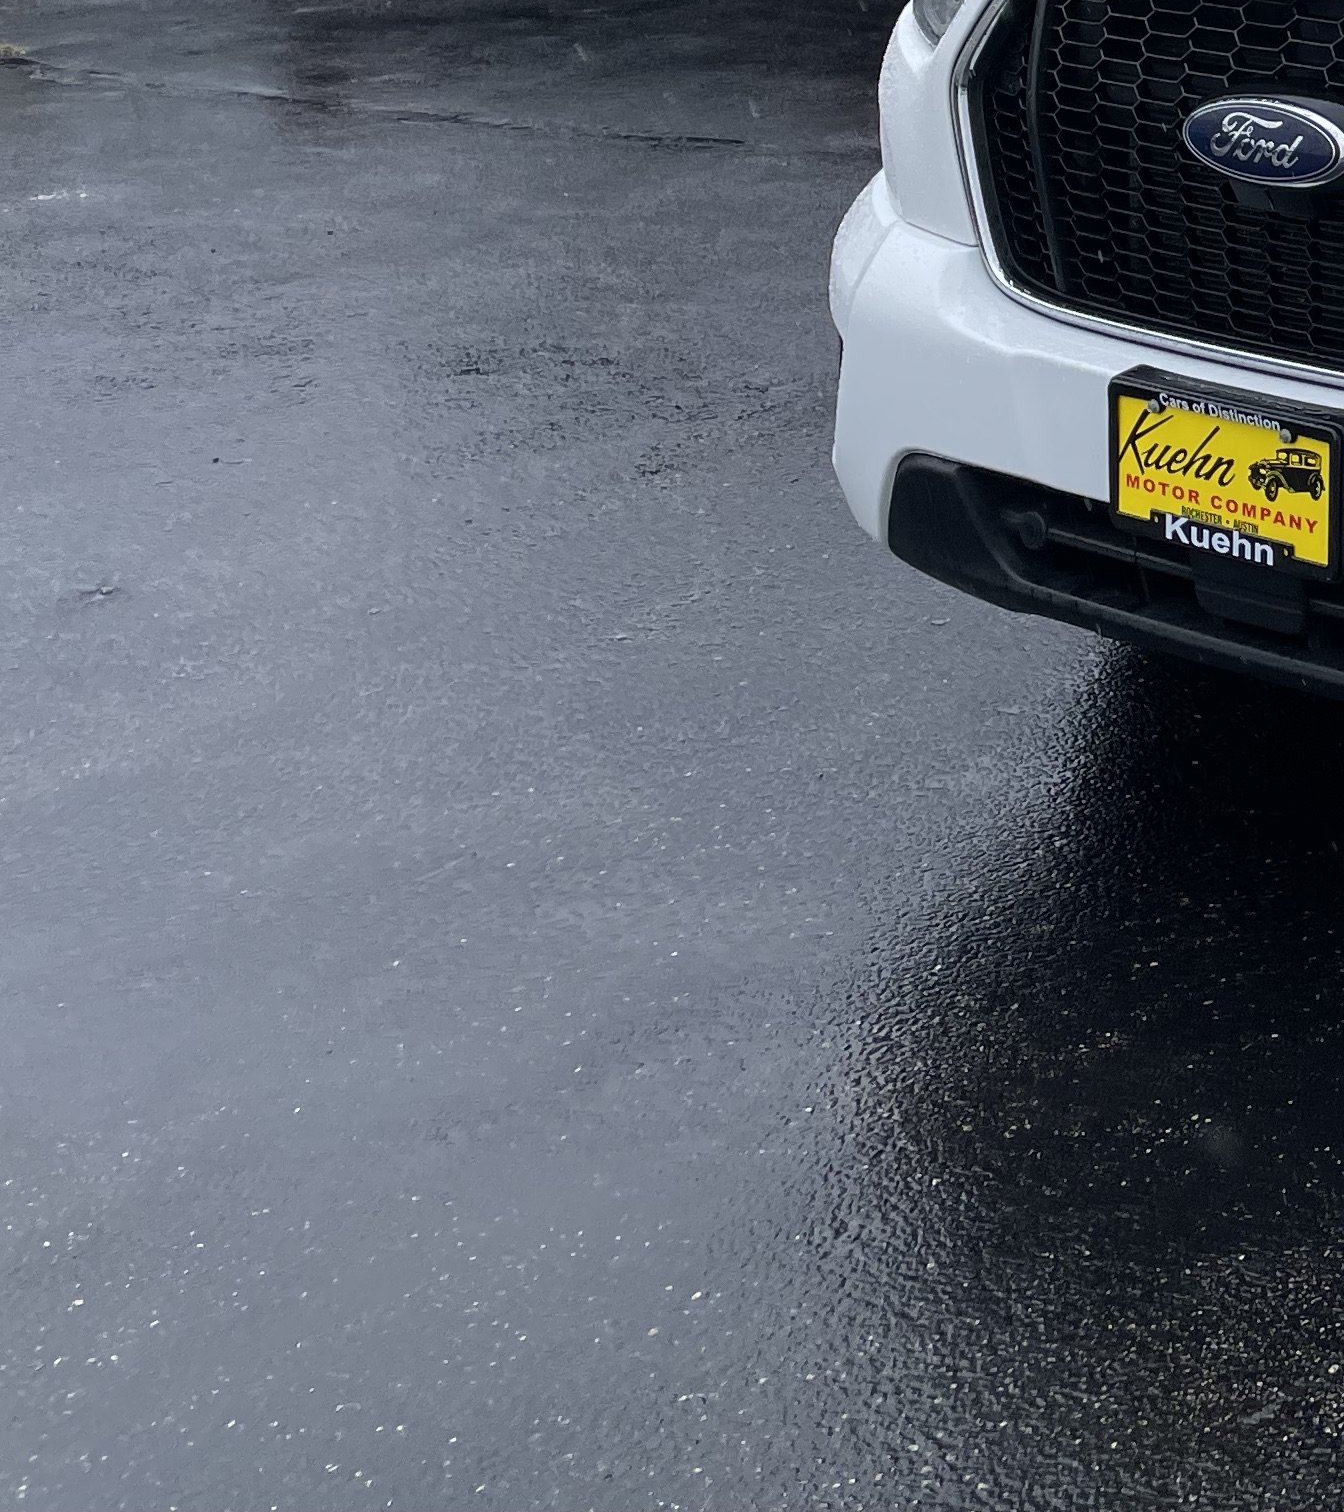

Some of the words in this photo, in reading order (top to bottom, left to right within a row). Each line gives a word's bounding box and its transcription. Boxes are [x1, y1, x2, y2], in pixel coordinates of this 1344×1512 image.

[1210, 111, 1304, 169] Ford
[1159, 392, 1189, 411] Cars
[1192, 402, 1205, 414] of
[1208, 404, 1281, 432] Distinction
[1117, 408, 1236, 487] Kuehn
[1126, 473, 1200, 506] MOTOR
[1210, 495, 1319, 534] COMPANY
[1181, 505, 1223, 525] ROCHESTER
[1232, 519, 1259, 534] AUSTIN
[1165, 513, 1274, 567] Kuehn
